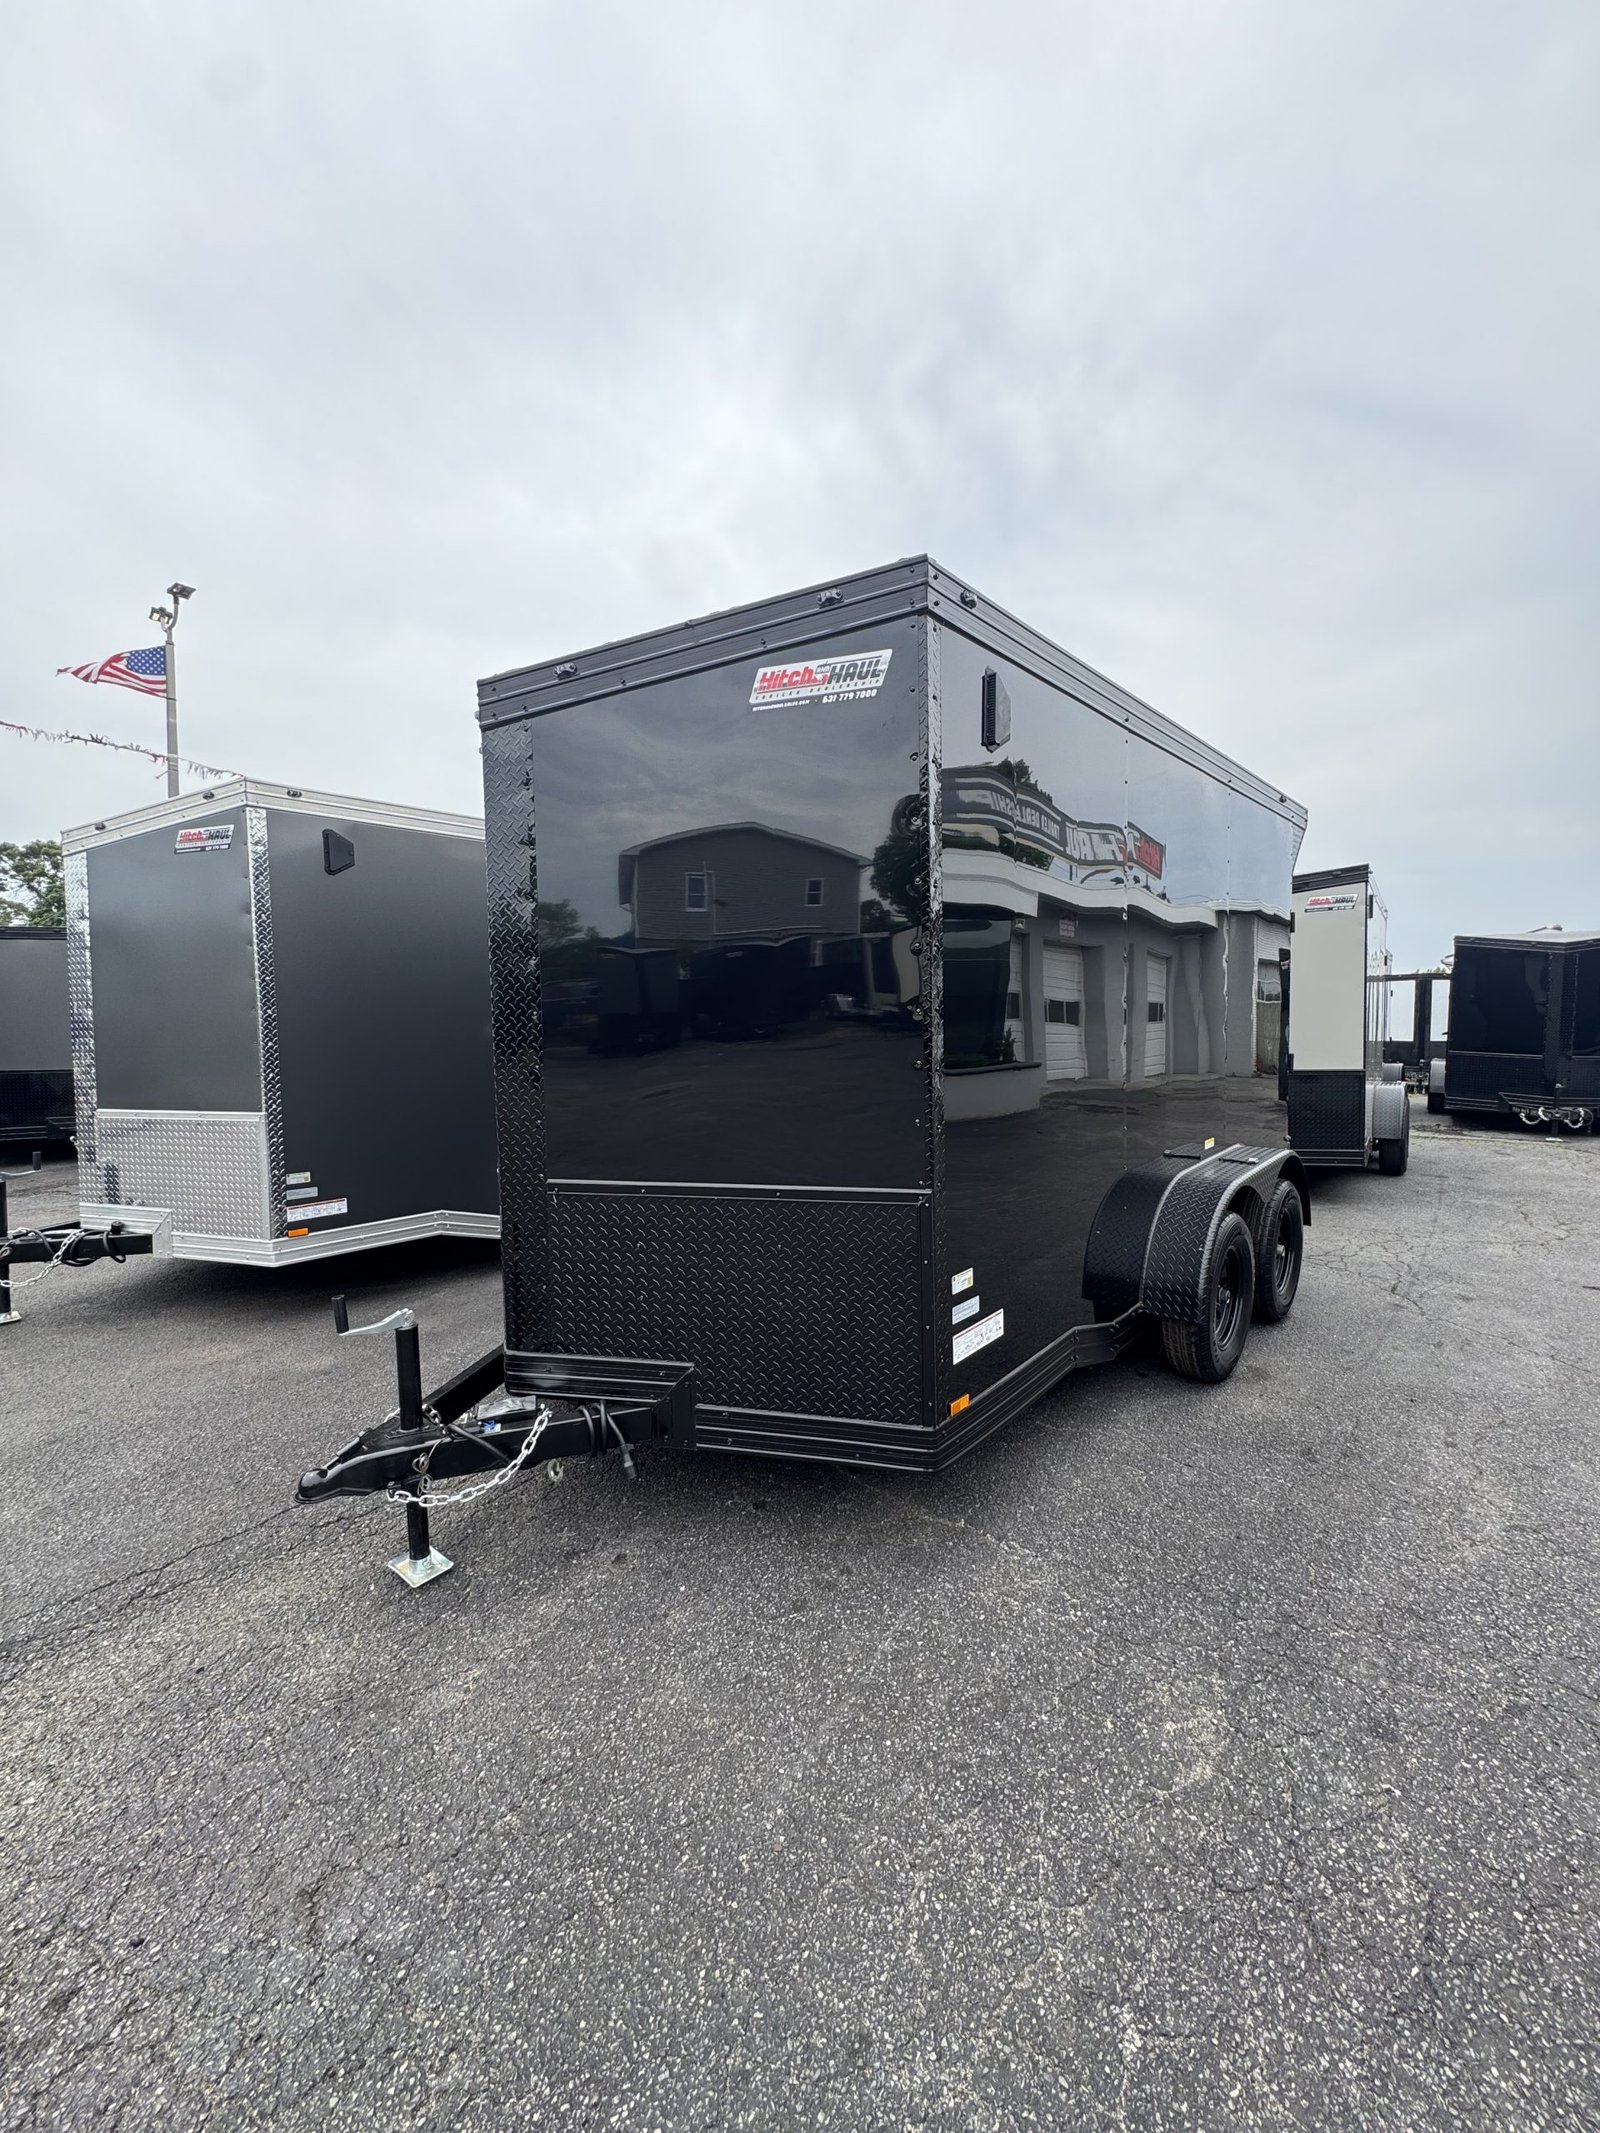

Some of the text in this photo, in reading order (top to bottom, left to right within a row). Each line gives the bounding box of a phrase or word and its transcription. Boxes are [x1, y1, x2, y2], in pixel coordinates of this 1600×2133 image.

[757, 665, 818, 691] Hitch
[827, 659, 885, 684] HAUL
[822, 694, 837, 704] 631
[838, 691, 854, 702] 779
[855, 688, 878, 699] 7000
[207, 829, 231, 841] HAUL
